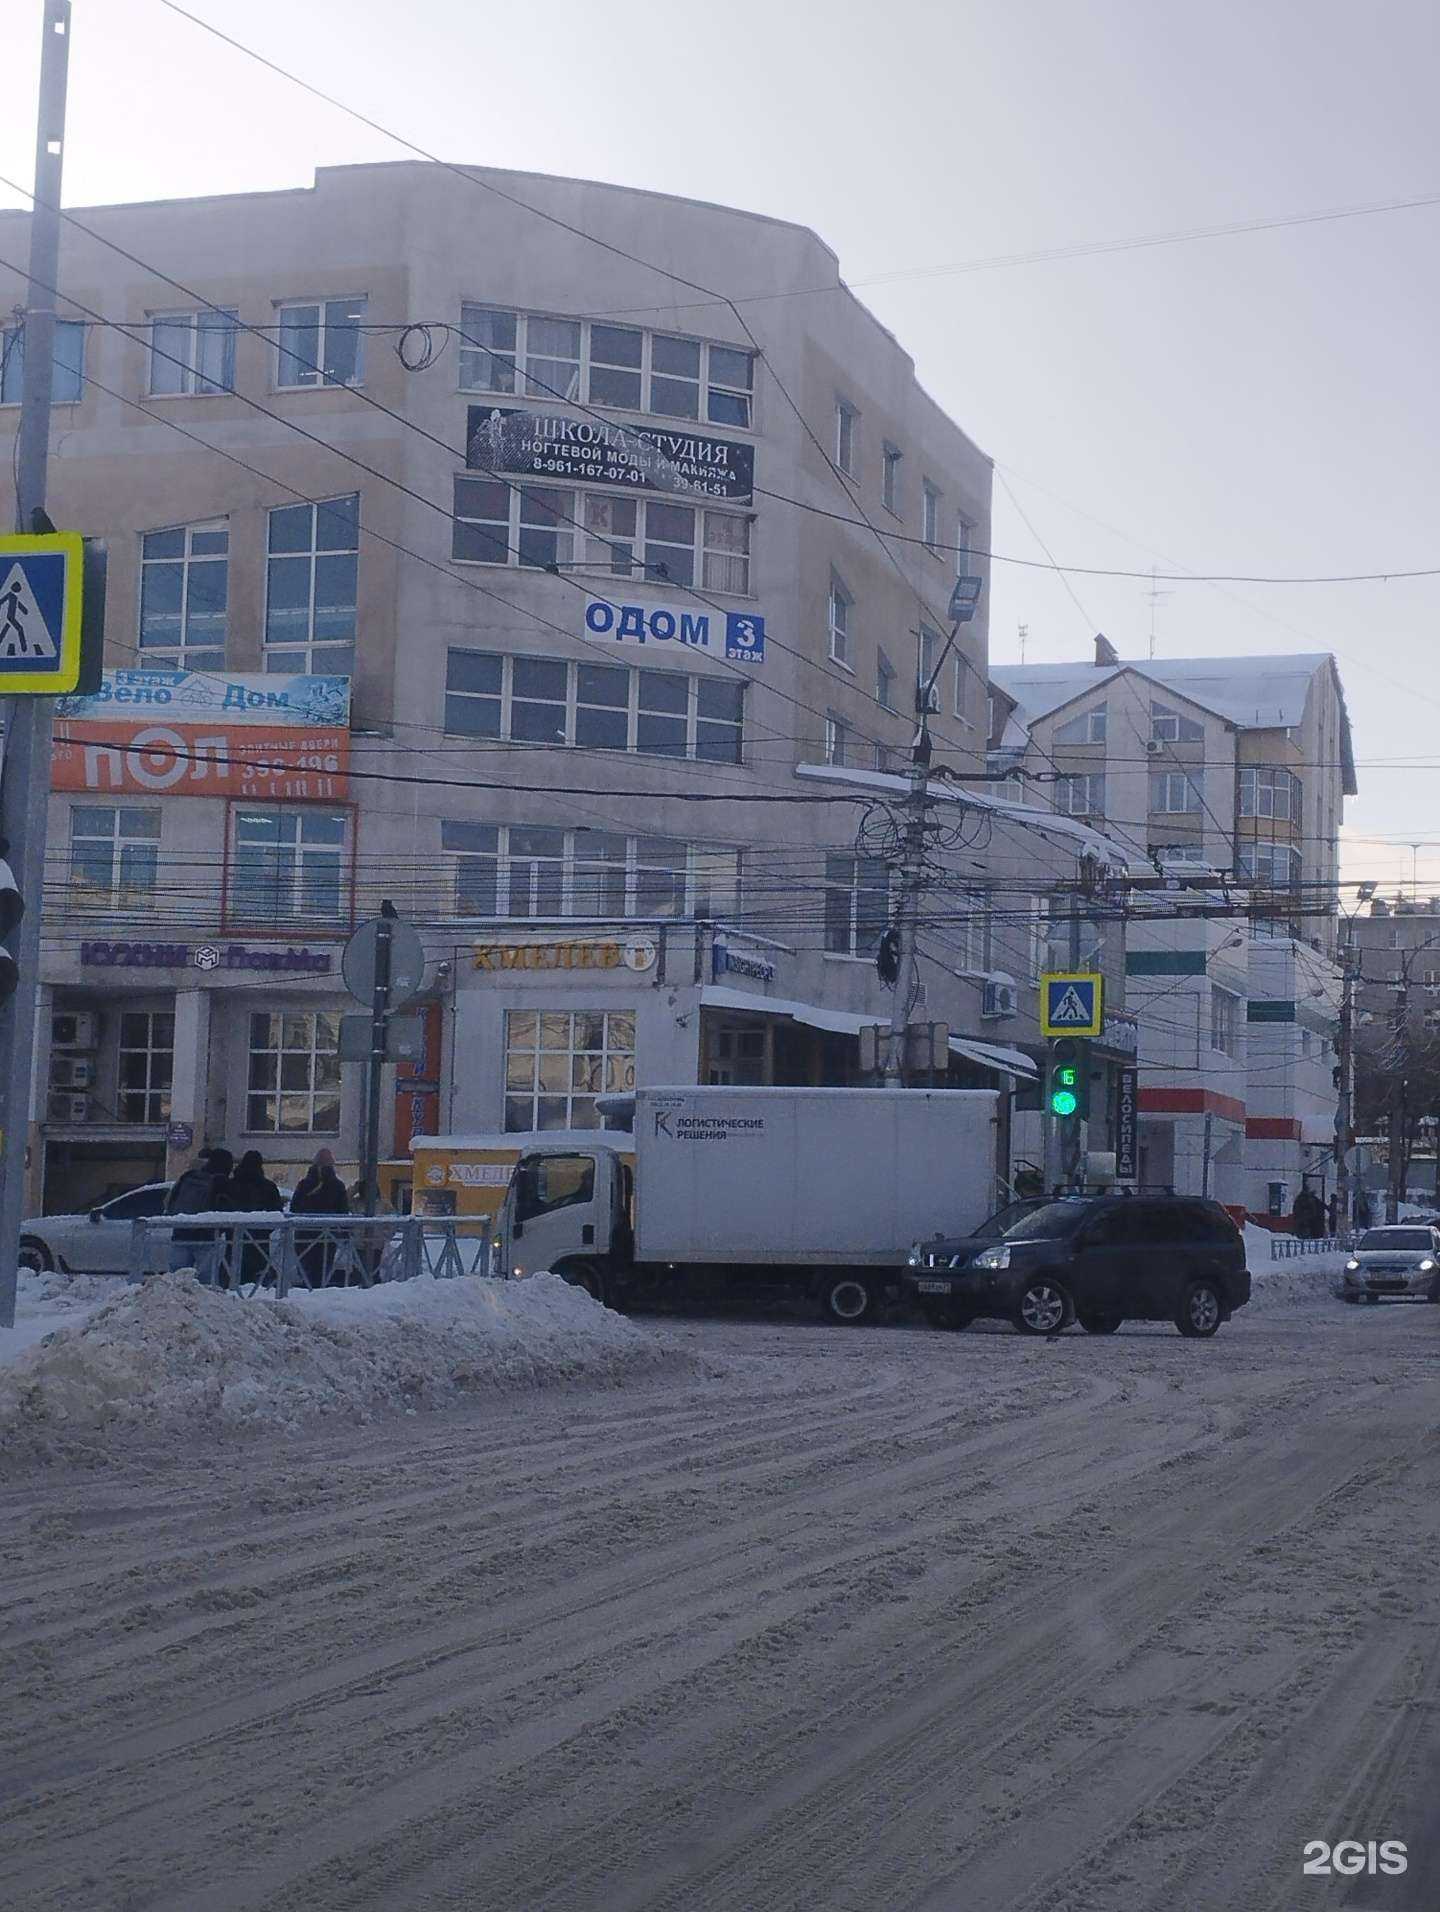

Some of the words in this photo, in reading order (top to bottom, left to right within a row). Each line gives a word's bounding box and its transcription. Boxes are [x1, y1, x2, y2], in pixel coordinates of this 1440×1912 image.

[521, 439, 602, 460] НОГТЕВОЙ
[607, 450, 651, 468] МОДЫ
[533, 416, 729, 465] ШКОЛА-СТУДИЯ
[533, 457, 645, 482] 8-961-167-07-01
[673, 476, 727, 496] 39-61-51
[586, 602, 709, 646] ОДОМ
[736, 620, 756, 647] 3
[728, 647, 763, 662] этаж
[93, 681, 172, 704] Вело
[223, 683, 289, 712] Дом
[676, 1117, 764, 1129] ЛОГИСТИЧЕСКИЕ
[676, 1129, 727, 1140] РЕШЕНИЯ
[1118, 1073, 1134, 1175] ВЕЛОСИПЕДЫ
